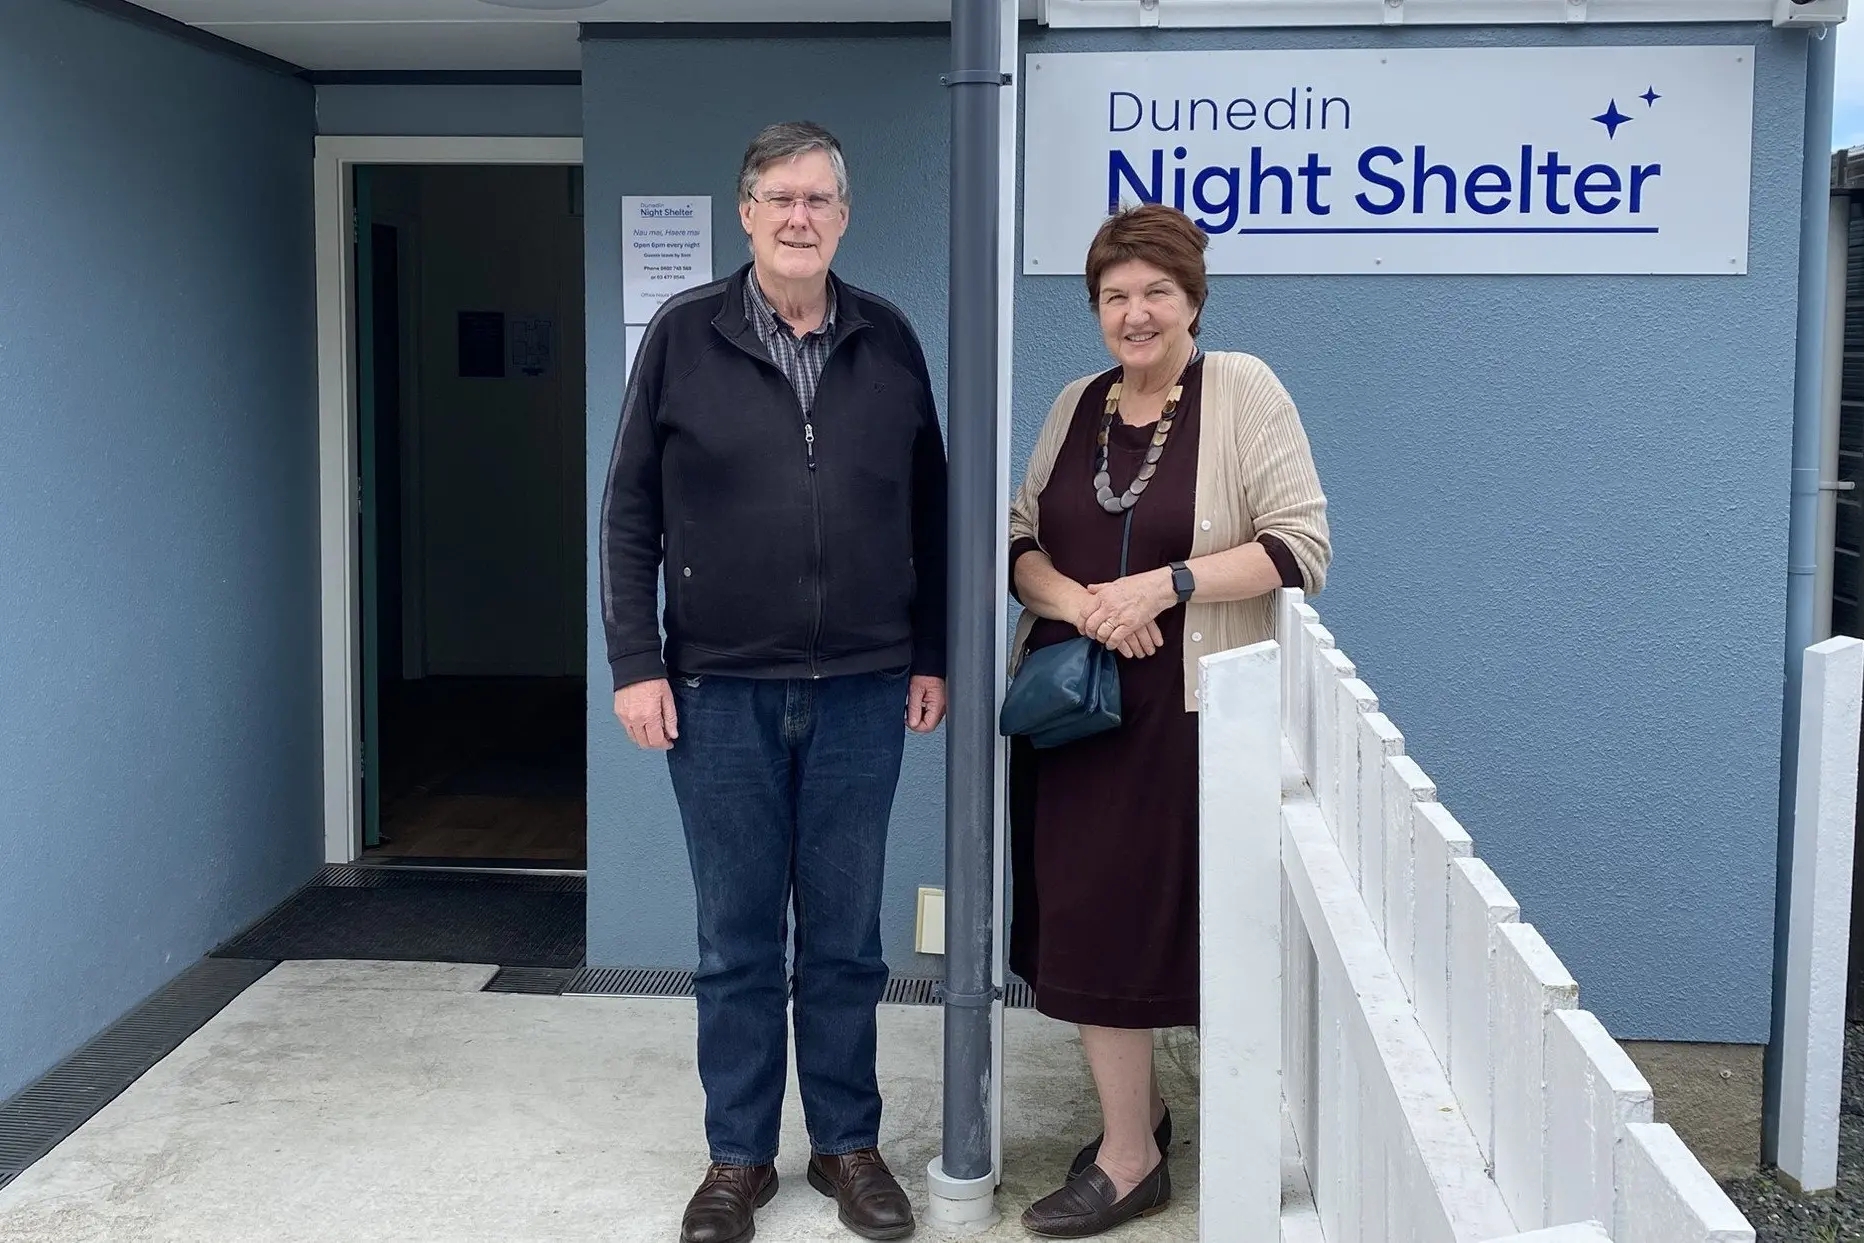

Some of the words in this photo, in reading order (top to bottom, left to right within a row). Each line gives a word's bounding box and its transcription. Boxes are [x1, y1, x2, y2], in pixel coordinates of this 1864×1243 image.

[1109, 87, 1351, 133] Dunedin
[1108, 146, 1332, 234] Night
[1355, 144, 1662, 216] Shelter
[640, 208, 663, 218] Night
[664, 208, 693, 216] Shelter
